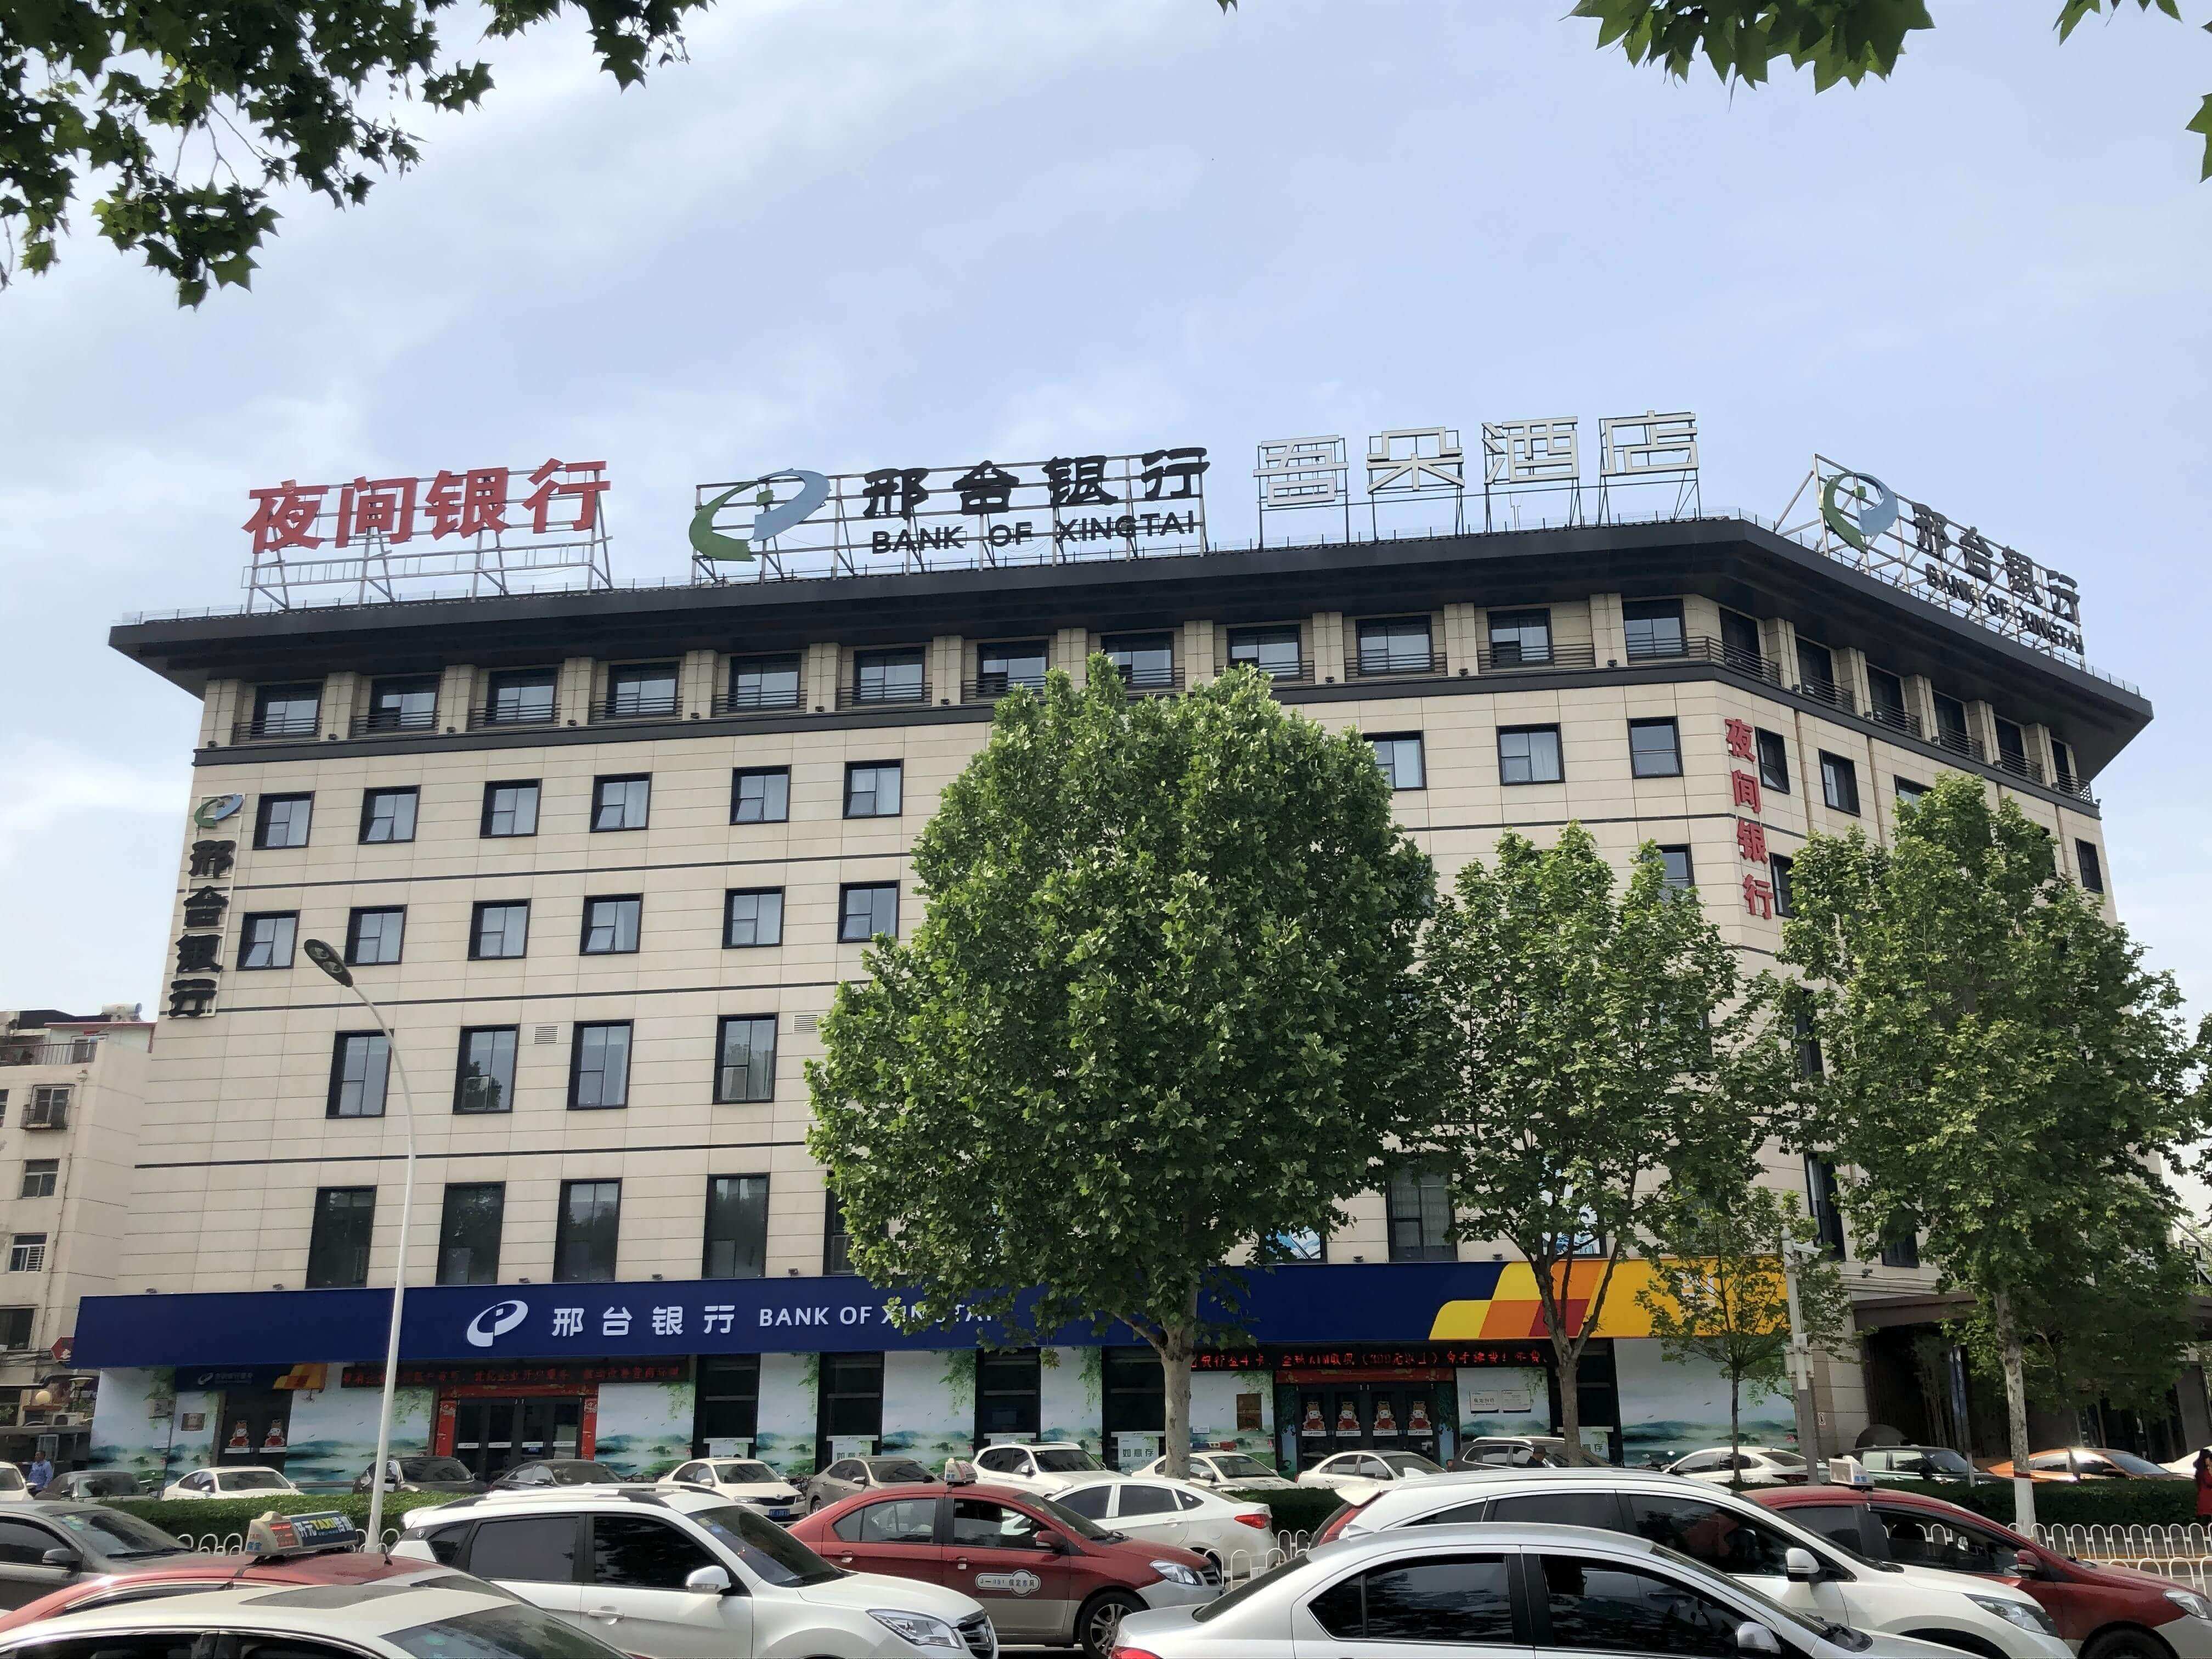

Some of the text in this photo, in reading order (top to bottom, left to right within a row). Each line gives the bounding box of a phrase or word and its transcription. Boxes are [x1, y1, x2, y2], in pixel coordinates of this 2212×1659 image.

[862, 447, 1210, 520] 邢台银行
[1253, 410, 1698, 507] 吾朵酒店
[242, 458, 611, 554] 夜间银行
[872, 510, 1194, 554] BANK OF XINGTAI
[1911, 500, 2080, 622] 邢台银行
[1724, 718, 1774, 919] 夜间银行
[552, 1305, 735, 1337] 邢台银行
[759, 1307, 830, 1327] BANK
[840, 1306, 872, 1325] OF
